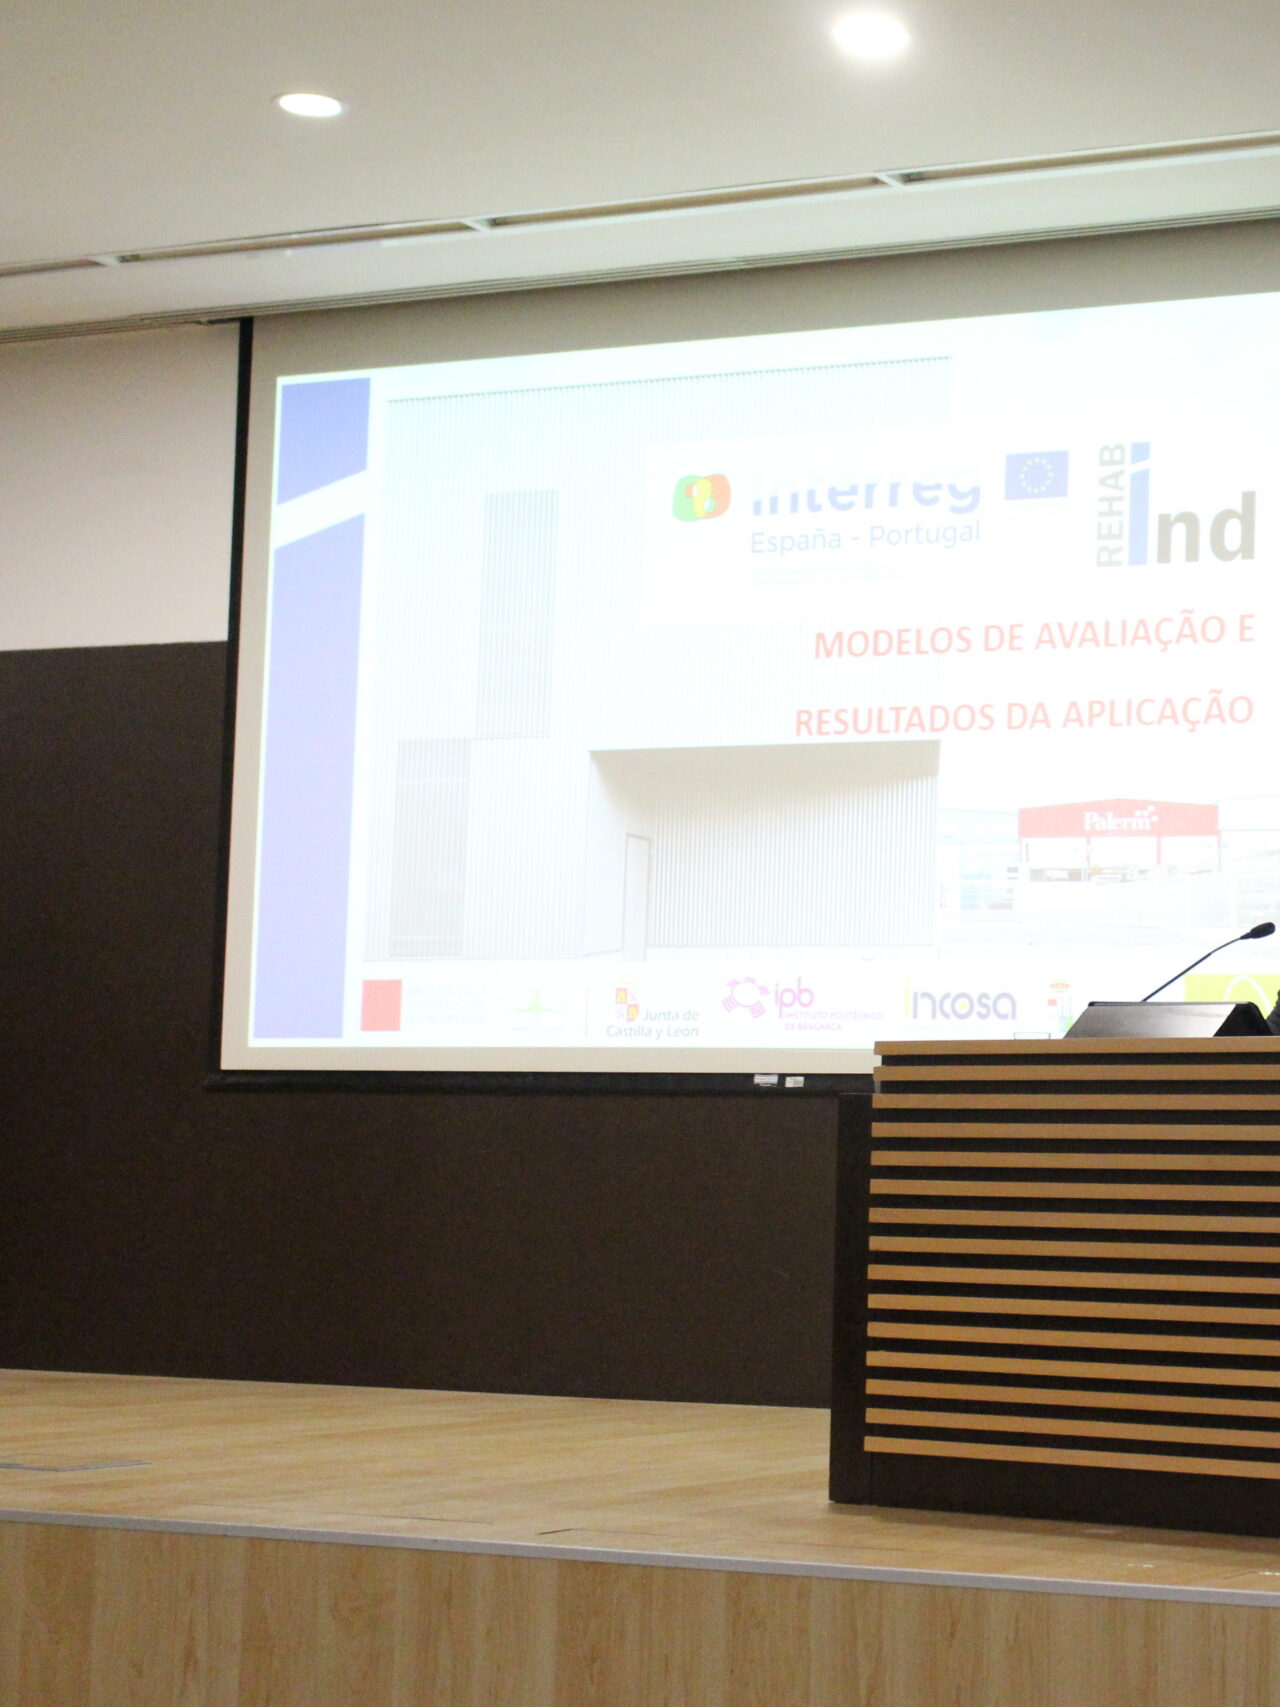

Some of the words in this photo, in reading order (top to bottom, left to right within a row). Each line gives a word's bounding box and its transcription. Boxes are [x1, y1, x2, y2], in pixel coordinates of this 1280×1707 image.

[1097, 443, 1126, 568] REHAB
[751, 527, 841, 557] España
[870, 518, 981, 550] Portugal
[815, 625, 972, 659] MODELOS
[983, 623, 1024, 652] DE
[1034, 608, 1226, 653] AVALIAÇÃO
[1239, 613, 1256, 643] E
[795, 702, 995, 736] RESULTADOS
[1007, 701, 1052, 730] DA
[1062, 688, 1254, 733] APLICAÇÃO
[643, 1008, 680, 1022] Junta
[682, 1008, 699, 1021] de
[774, 976, 815, 1020] ipb
[904, 976, 1017, 1020] incosa
[606, 1024, 652, 1037] Castilla
[654, 1027, 664, 1040] y
[666, 1023, 699, 1037] León
